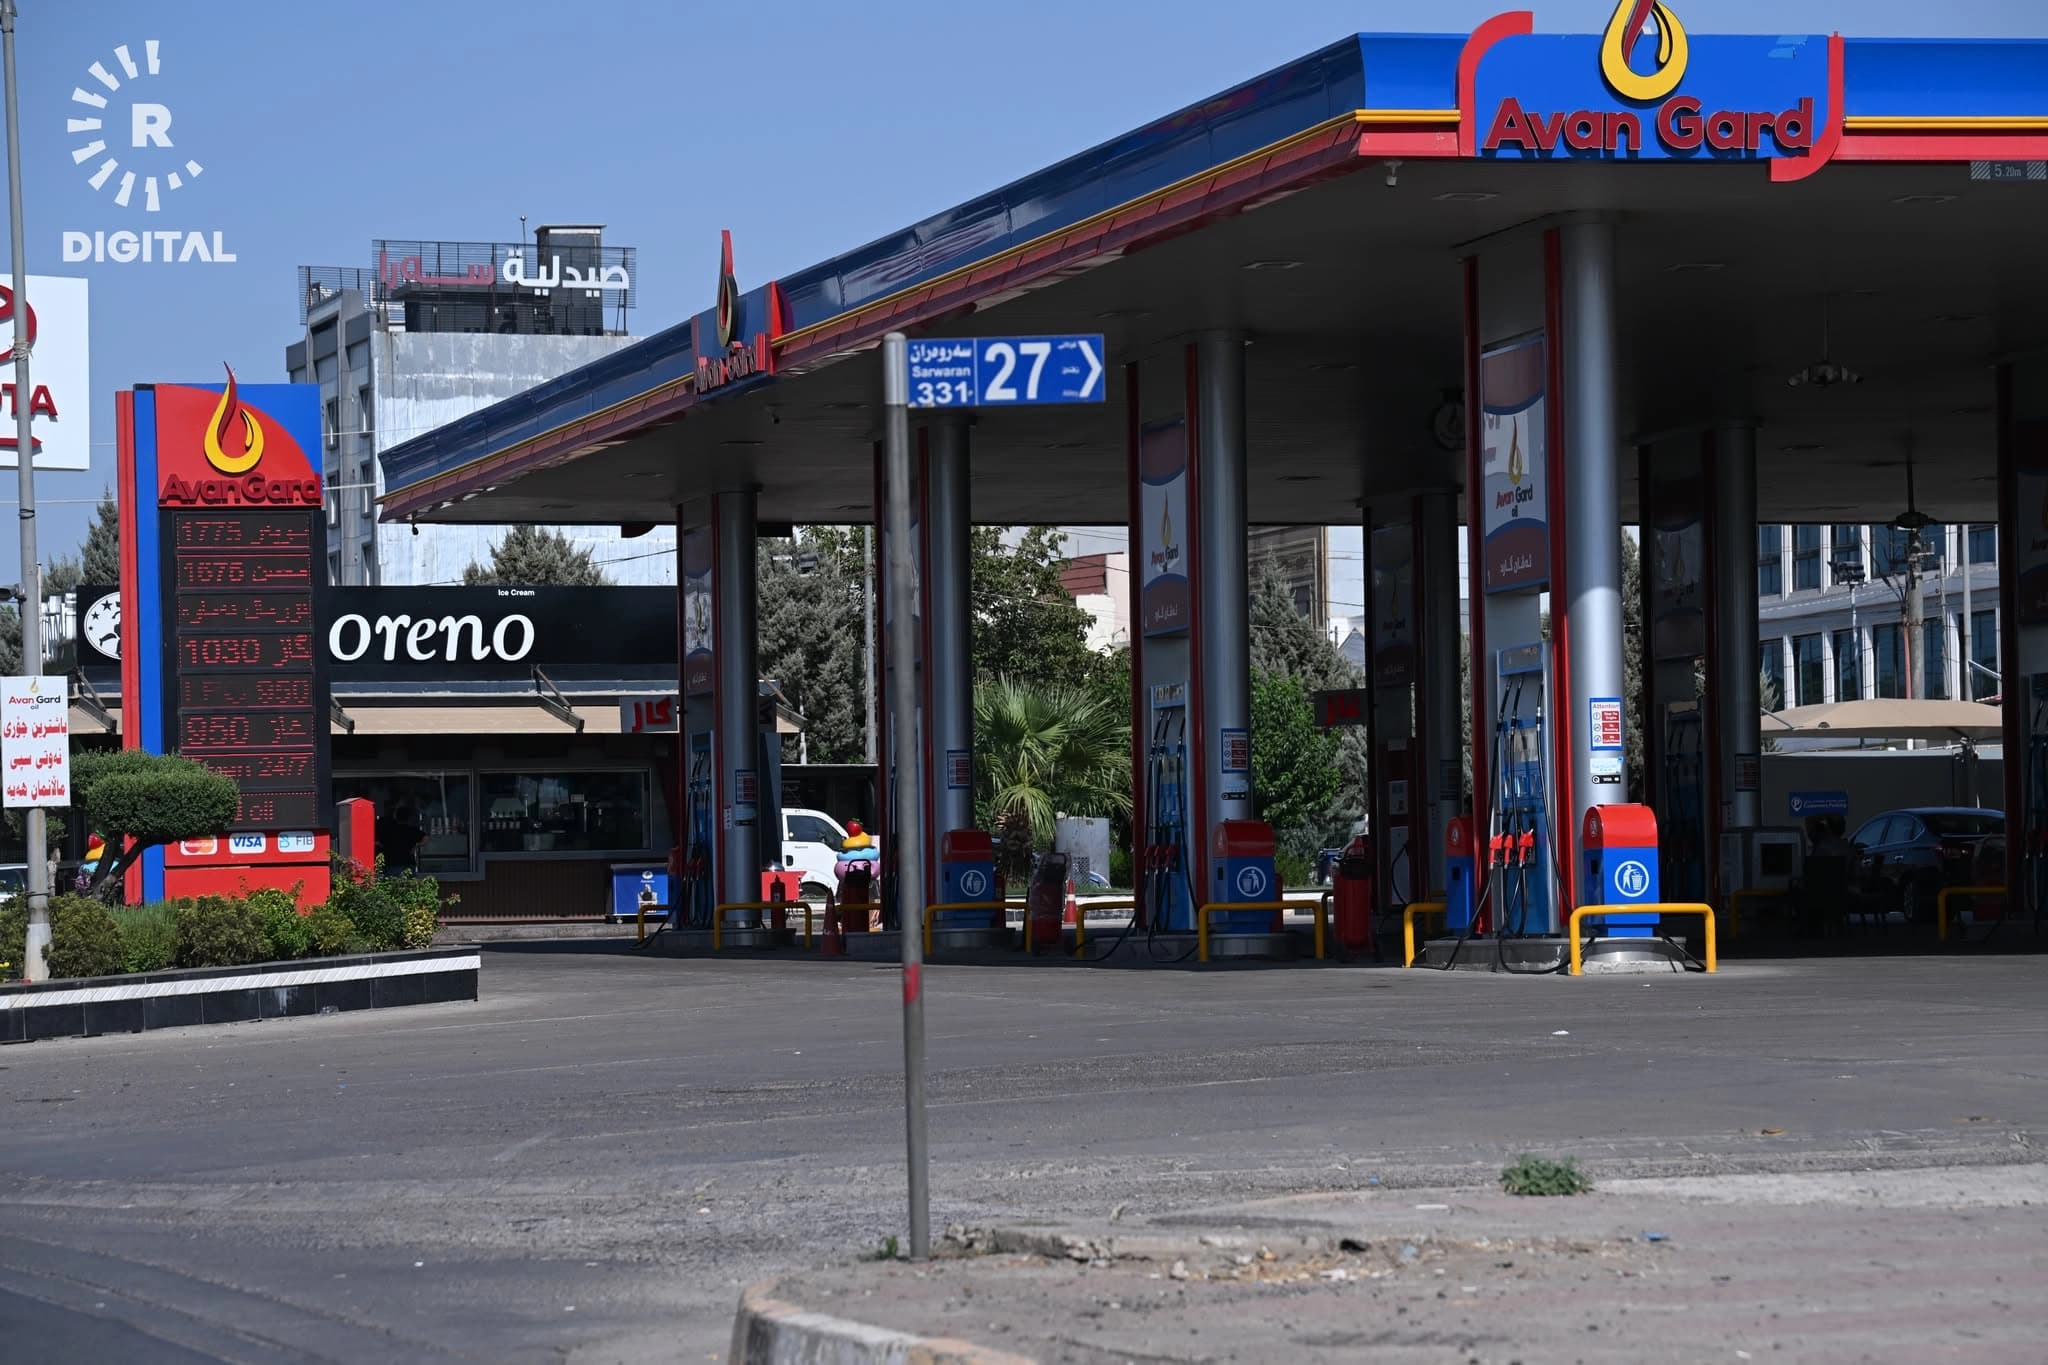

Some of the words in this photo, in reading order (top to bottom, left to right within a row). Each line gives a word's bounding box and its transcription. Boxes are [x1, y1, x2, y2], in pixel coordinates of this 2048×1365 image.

[1484, 97, 1641, 150] Avan
[1657, 95, 1815, 149] Gard
[502, 248, 630, 298] صيدلية
[912, 366, 971, 378] Sarwaran
[984, 340, 1051, 401] 27
[0, 383, 58, 417] TA
[917, 381, 968, 404] 331
[1515, 484, 1533, 503] Gard
[185, 639, 261, 664] 1030
[8, 695, 34, 704] Avan
[36, 695, 61, 704] Gard
[257, 757, 309, 777] 24/7
[233, 836, 263, 847] VISA
[296, 835, 313, 846] FIB
